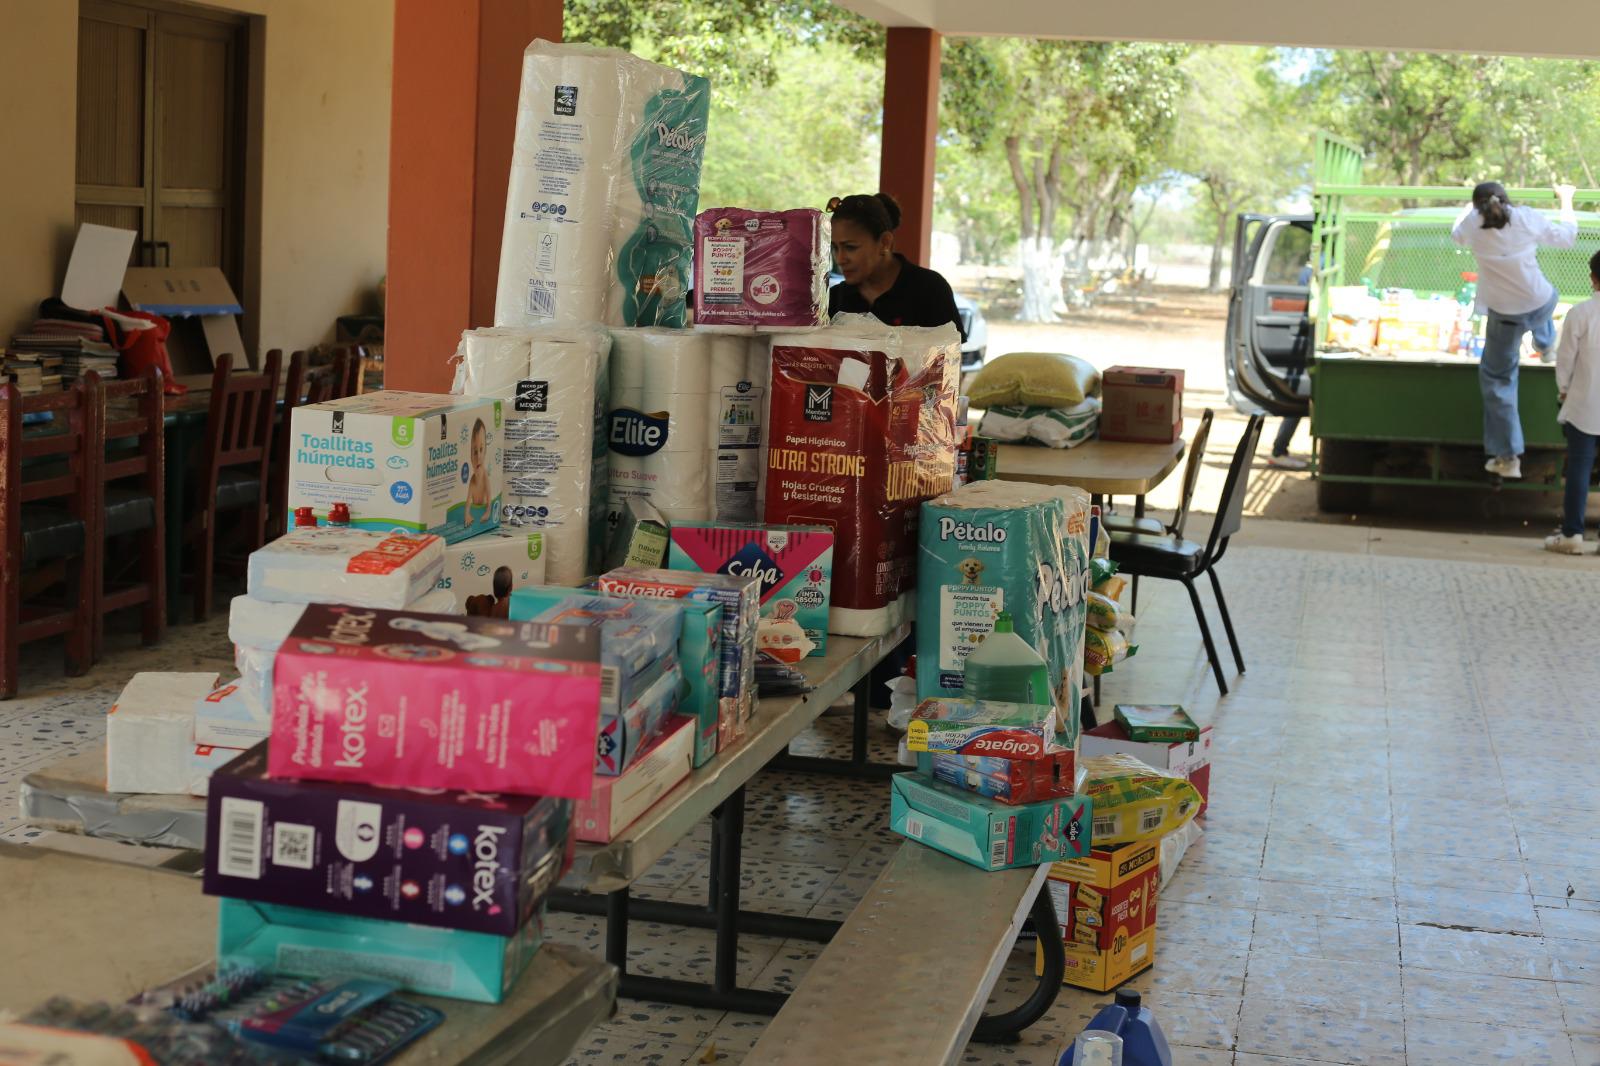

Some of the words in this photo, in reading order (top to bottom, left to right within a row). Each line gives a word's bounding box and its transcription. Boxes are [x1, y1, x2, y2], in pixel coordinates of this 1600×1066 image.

[805, 408, 831, 416] Member's
[398, 425, 407, 437] 6
[610, 416, 661, 447] Elite
[785, 435, 807, 446] Papel
[808, 436, 846, 447] Higiénico
[301, 433, 373, 453] Toallitas
[428, 442, 458, 462] Toallitas
[297, 449, 376, 470] húmedas
[426, 458, 458, 480] húmedas
[769, 448, 807, 472] ULTRA
[810, 452, 866, 477] STRONG
[608, 469, 629, 479] Ultra
[631, 470, 658, 482] Suave
[781, 480, 807, 492] Hojas
[808, 482, 846, 494] Gruesas
[783, 491, 789, 501] y
[791, 491, 842, 504] Resistentes
[939, 516, 1007, 543] Pétalo
[531, 544, 537, 552] 6
[727, 558, 779, 585] Saba
[602, 580, 677, 599] Colgate
[953, 608, 990, 617] PUNTOS
[956, 601, 986, 609] POPPY
[333, 687, 368, 768] kotex
[974, 739, 1040, 756] Colgate
[1069, 821, 1079, 841] Saba
[472, 824, 507, 906] kotex
[1113, 934, 1121, 955] 20
